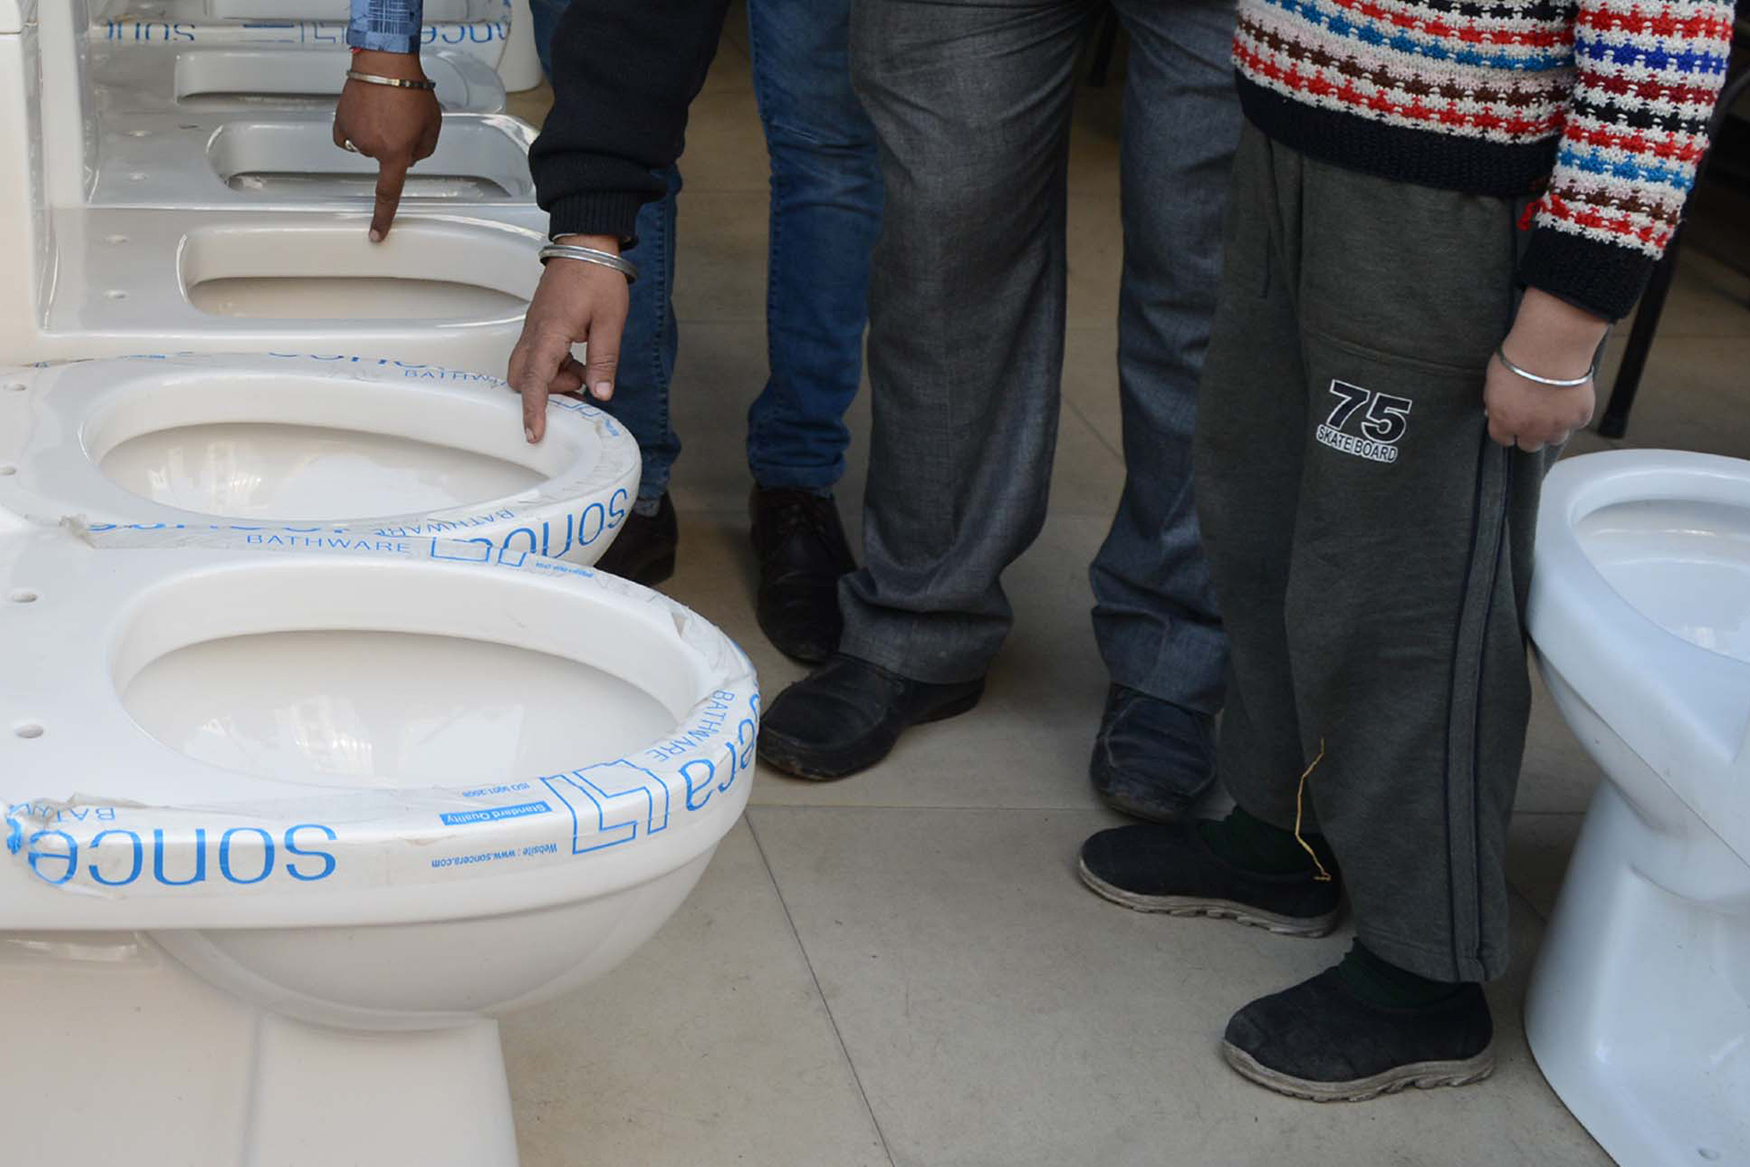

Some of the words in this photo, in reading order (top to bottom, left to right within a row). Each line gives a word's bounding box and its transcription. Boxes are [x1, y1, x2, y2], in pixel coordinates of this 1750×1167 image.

[1326, 379, 1413, 444] 75
[1316, 424, 1353, 452] SKATE
[1353, 438, 1398, 462] BOARD
[246, 534, 411, 553] BATHWARE
[646, 689, 734, 762] BATHWARE
[447, 812, 490, 824] Quality
[491, 803, 547, 819] Standard
[431, 849, 515, 868] www.soncera.com
[523, 842, 558, 856] Website
